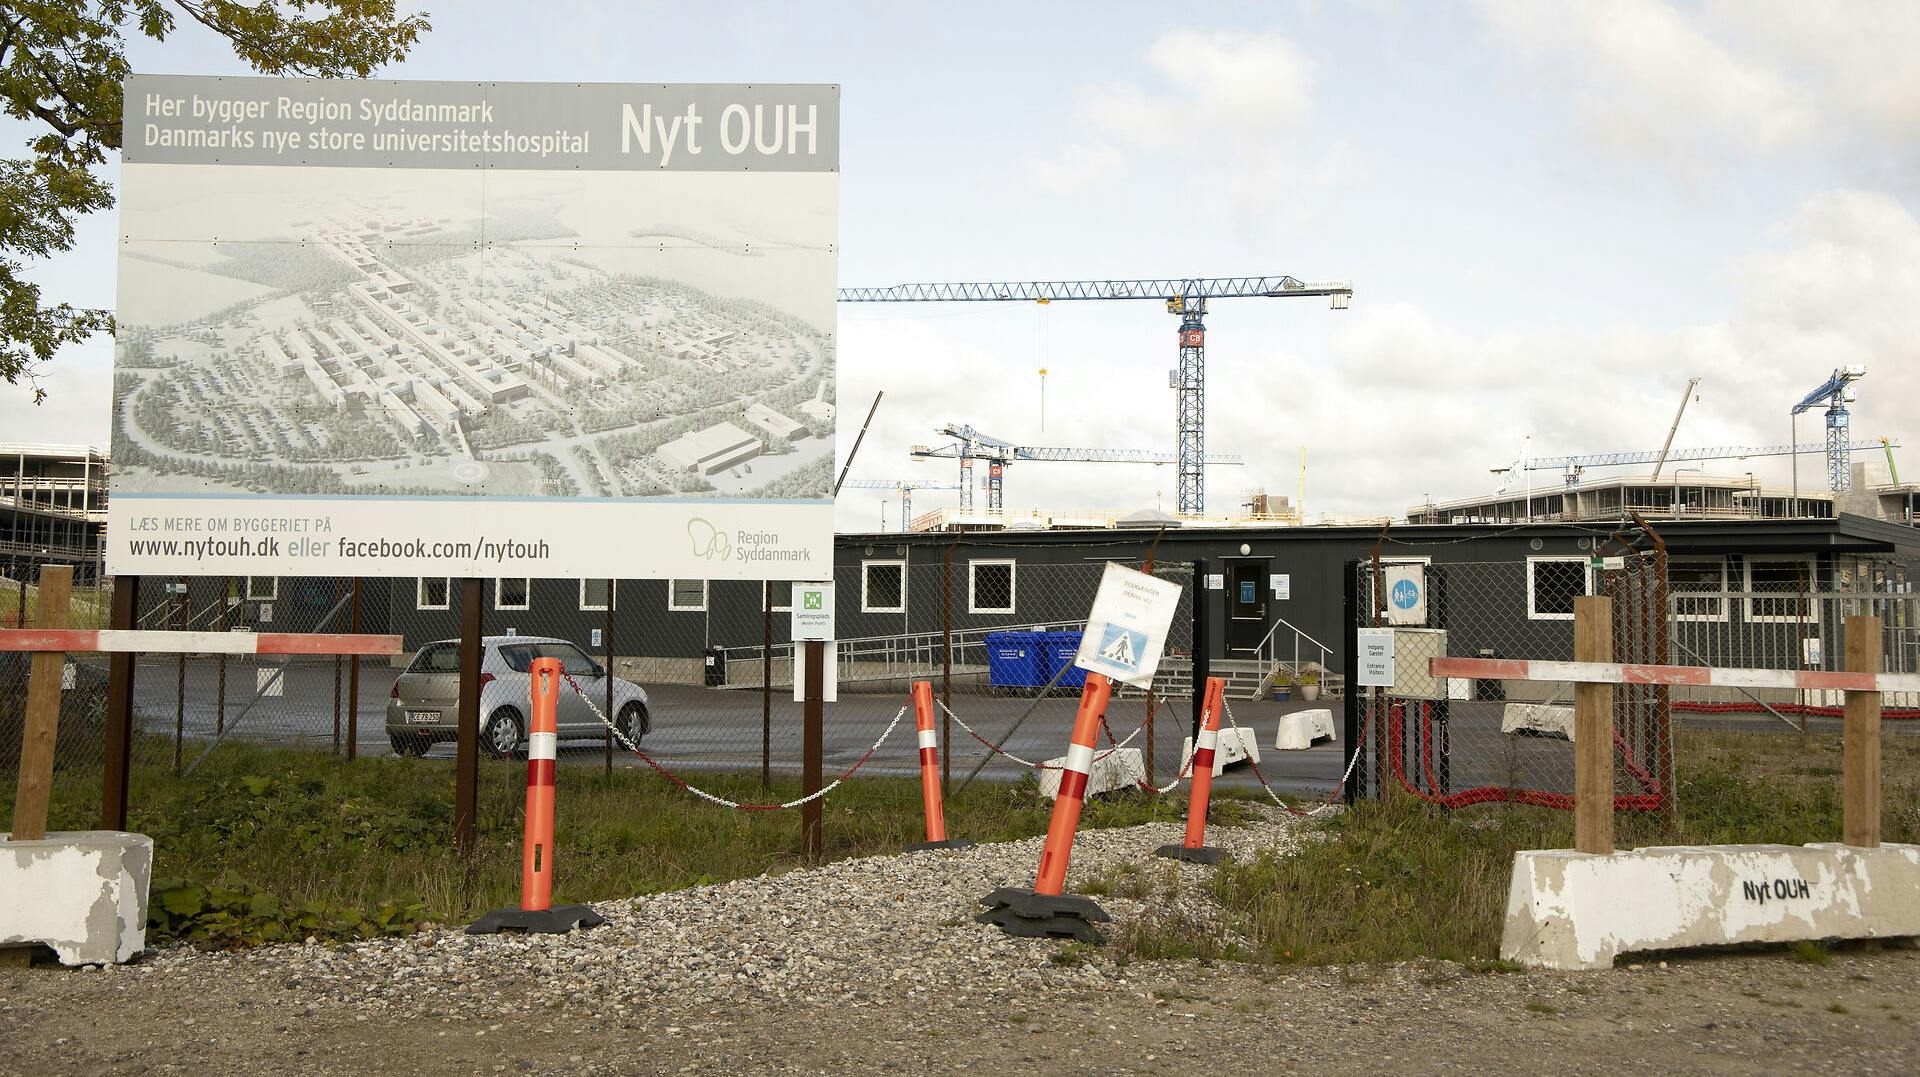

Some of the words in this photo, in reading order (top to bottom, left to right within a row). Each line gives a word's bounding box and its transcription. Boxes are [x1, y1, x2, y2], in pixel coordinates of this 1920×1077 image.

[145, 93, 185, 117] Her
[193, 94, 270, 124] bygger
[277, 96, 351, 125] Region
[359, 98, 494, 127] Syddanmark
[144, 124, 255, 149] Danmarks
[262, 130, 300, 154] nye
[308, 127, 366, 151] store
[373, 129, 590, 159] universitetshospital
[621, 102, 702, 167] Nyt
[719, 103, 817, 155] OUH
[130, 517, 159, 531] LÆS
[164, 517, 202, 532] MERE
[207, 517, 228, 532] OM
[233, 518, 310, 533] BYGGERIET
[315, 516, 333, 533] PÅ
[737, 529, 778, 547] Region
[129, 536, 280, 561] www.nytouh.dk
[287, 537, 331, 558] eller
[338, 536, 550, 563] facebook.com/nytouh
[736, 547, 811, 563] Syddanmark
[1743, 880, 1772, 905] Nyt
[1774, 878, 1810, 900] OUH
